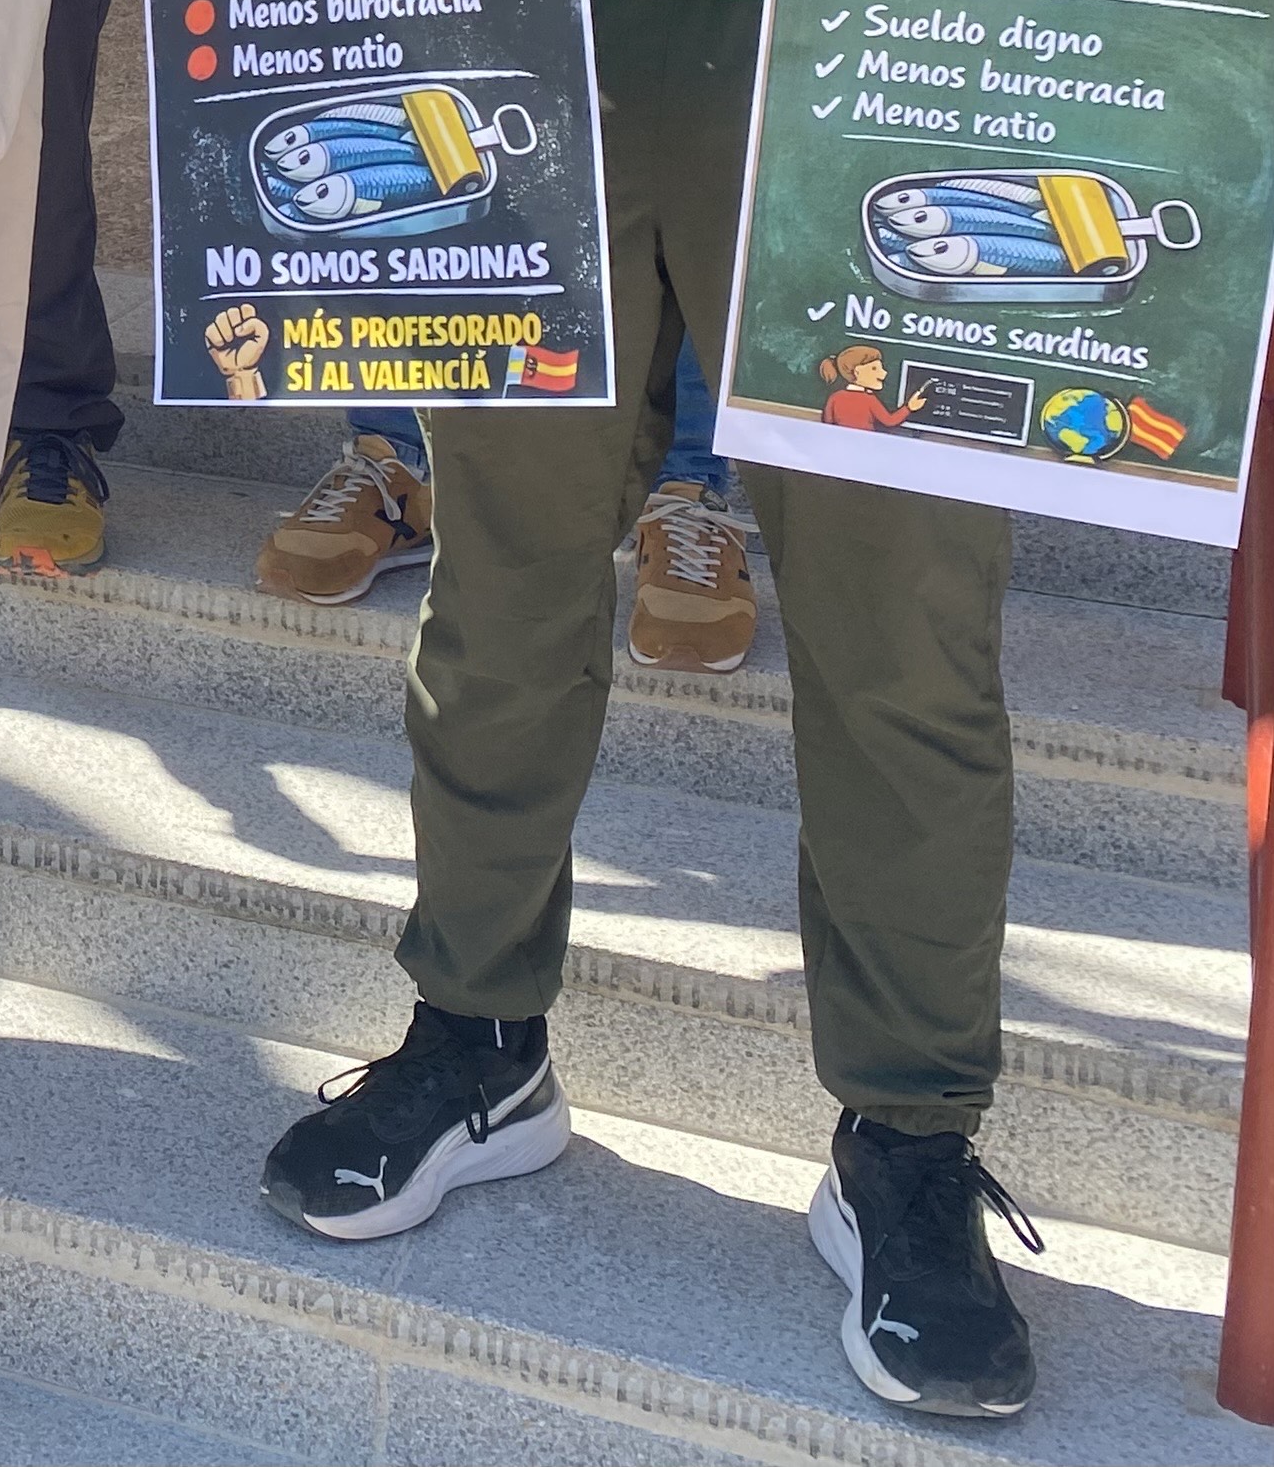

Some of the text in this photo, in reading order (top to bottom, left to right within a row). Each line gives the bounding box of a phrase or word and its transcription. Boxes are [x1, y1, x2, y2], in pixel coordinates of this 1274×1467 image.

[233, 33, 404, 78] Menos ratio
[863, 3, 1103, 63] Sueldo digno
[856, 48, 1166, 112] Menos burocracia
[851, 90, 1057, 144] Menos ratio
[205, 241, 551, 288] NO SOMOS SARDINAS
[283, 308, 543, 350] MÁS PROFESORADO
[844, 292, 1150, 371] No somos sardinas
[320, 361, 354, 392] AL
